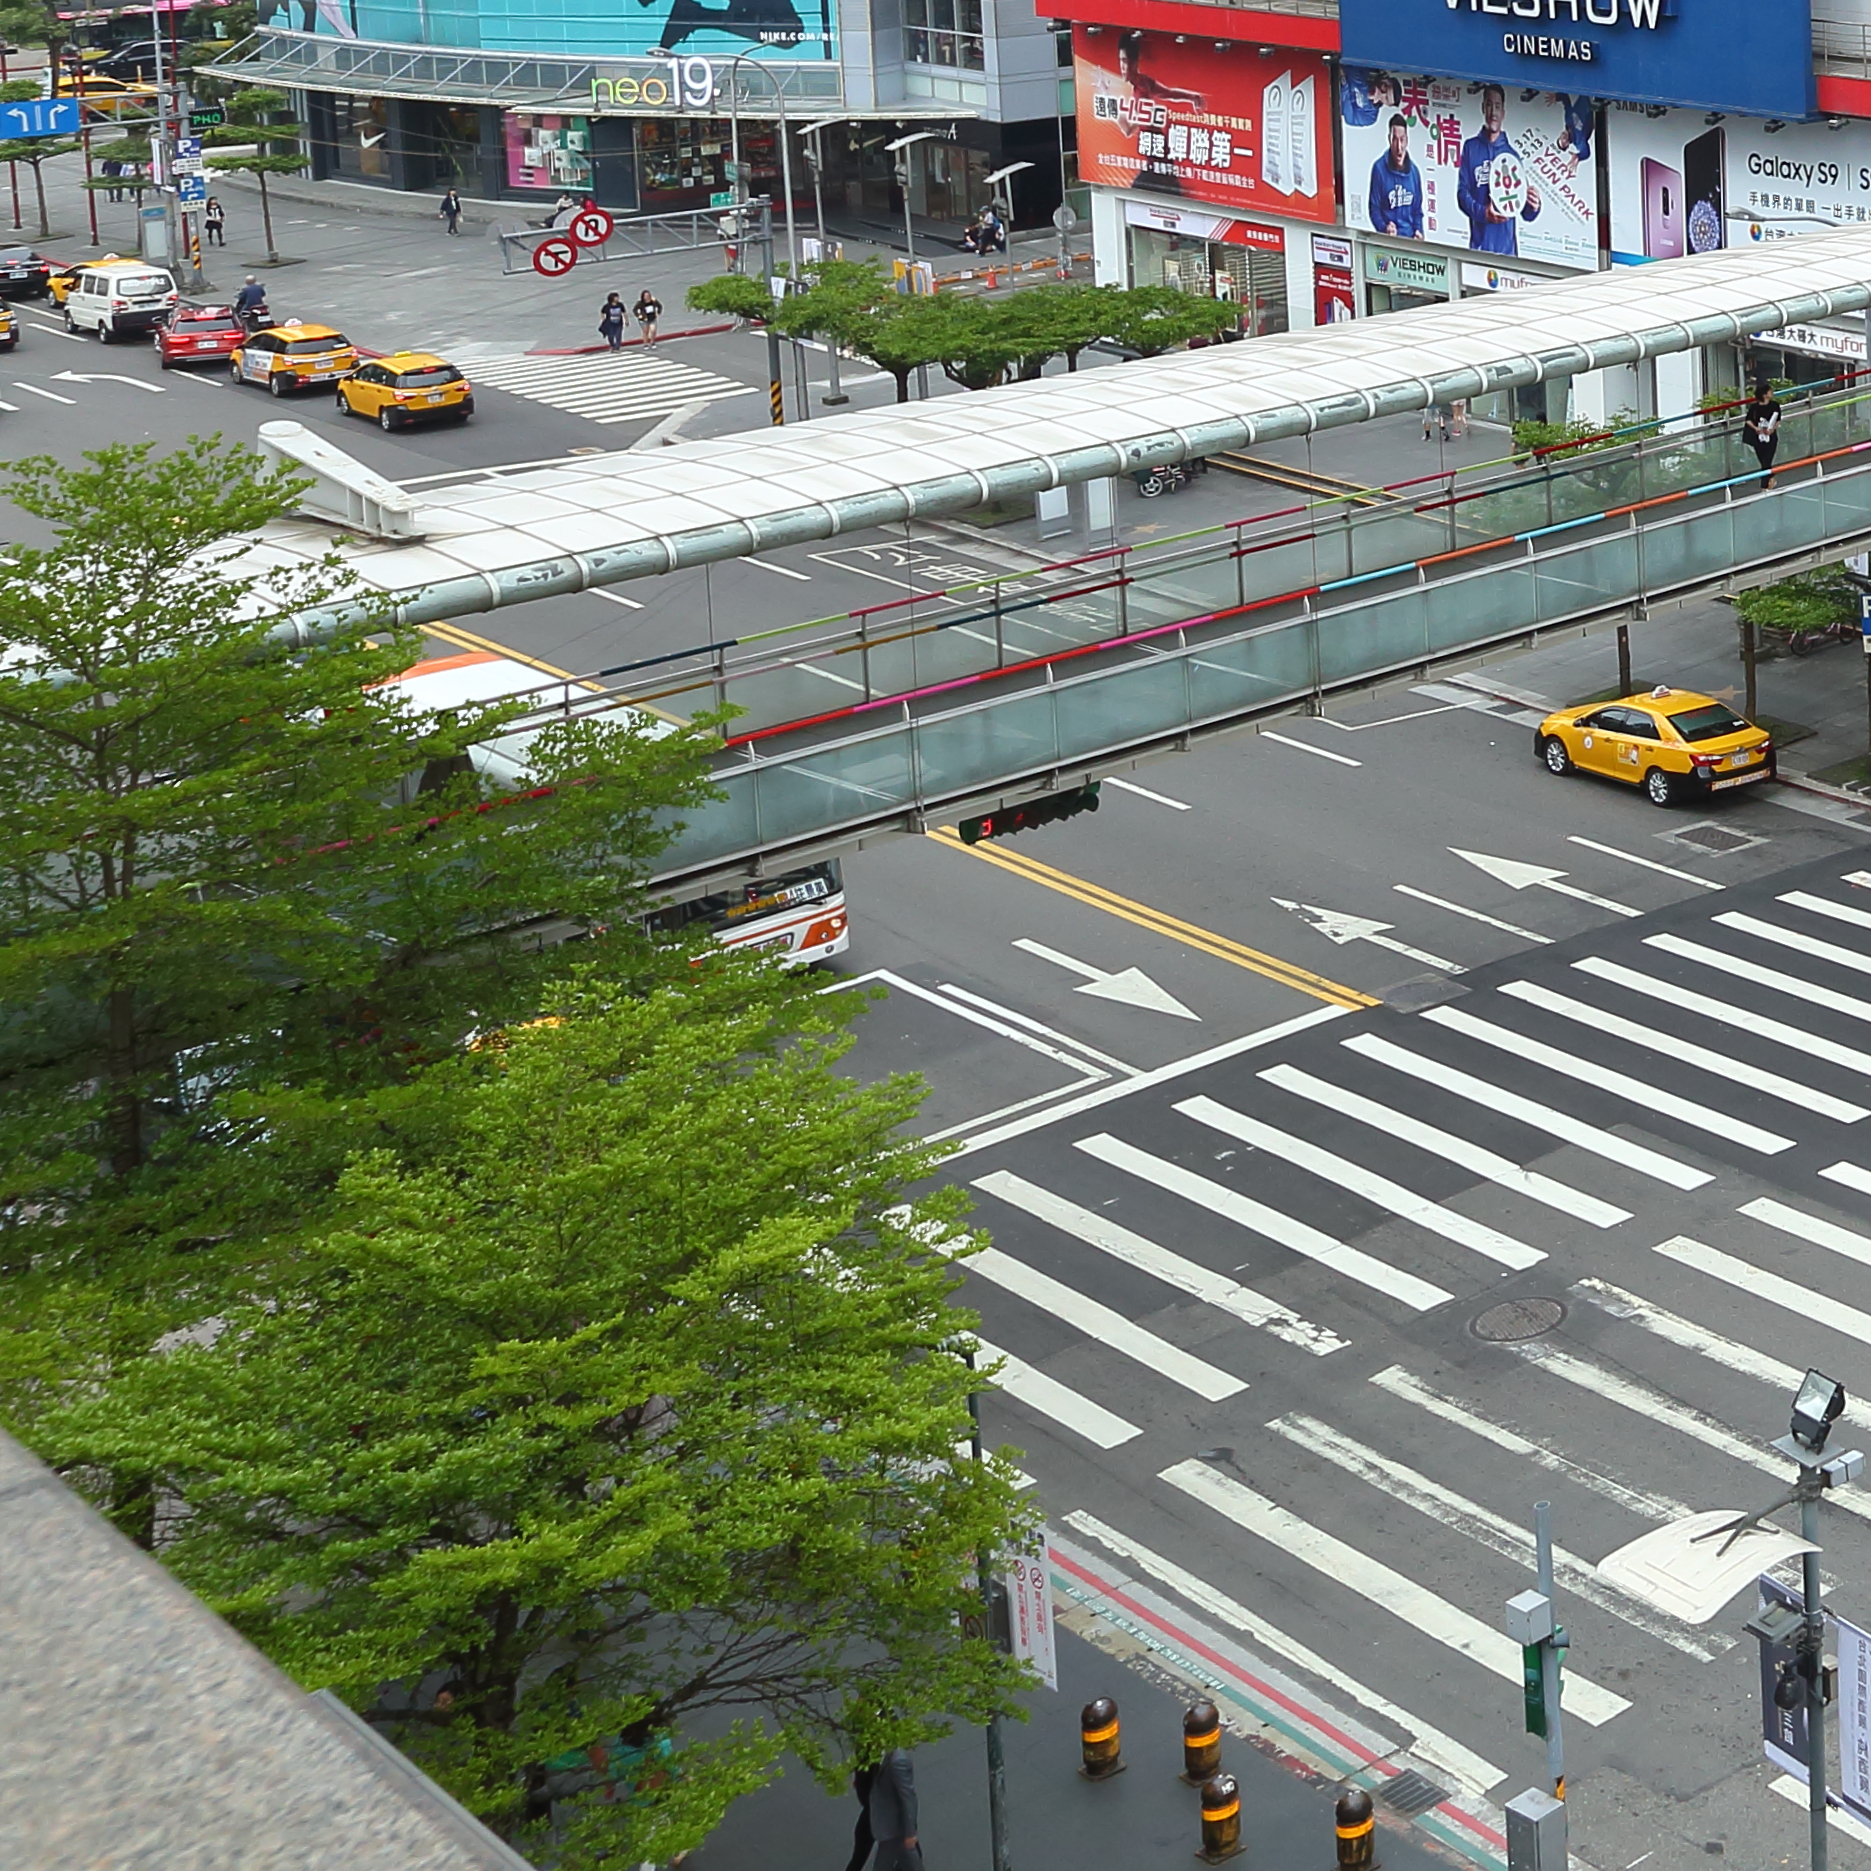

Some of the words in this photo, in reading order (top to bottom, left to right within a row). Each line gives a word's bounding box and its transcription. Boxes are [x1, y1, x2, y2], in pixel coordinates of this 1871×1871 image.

[1504, 33, 1592, 61] CINEMAS
[591, 56, 713, 106] neo19
[178, 140, 192, 153] P
[1533, 156, 1559, 186] FUN
[1542, 146, 1577, 181] VERY
[1749, 153, 1815, 188] Galaxy
[1818, 162, 1839, 185] S9
[181, 178, 194, 192] P
[1559, 185, 1595, 223] PARK
[1749, 191, 1816, 214] 手機界的單眼
[1391, 254, 1447, 277] VIESHOW
